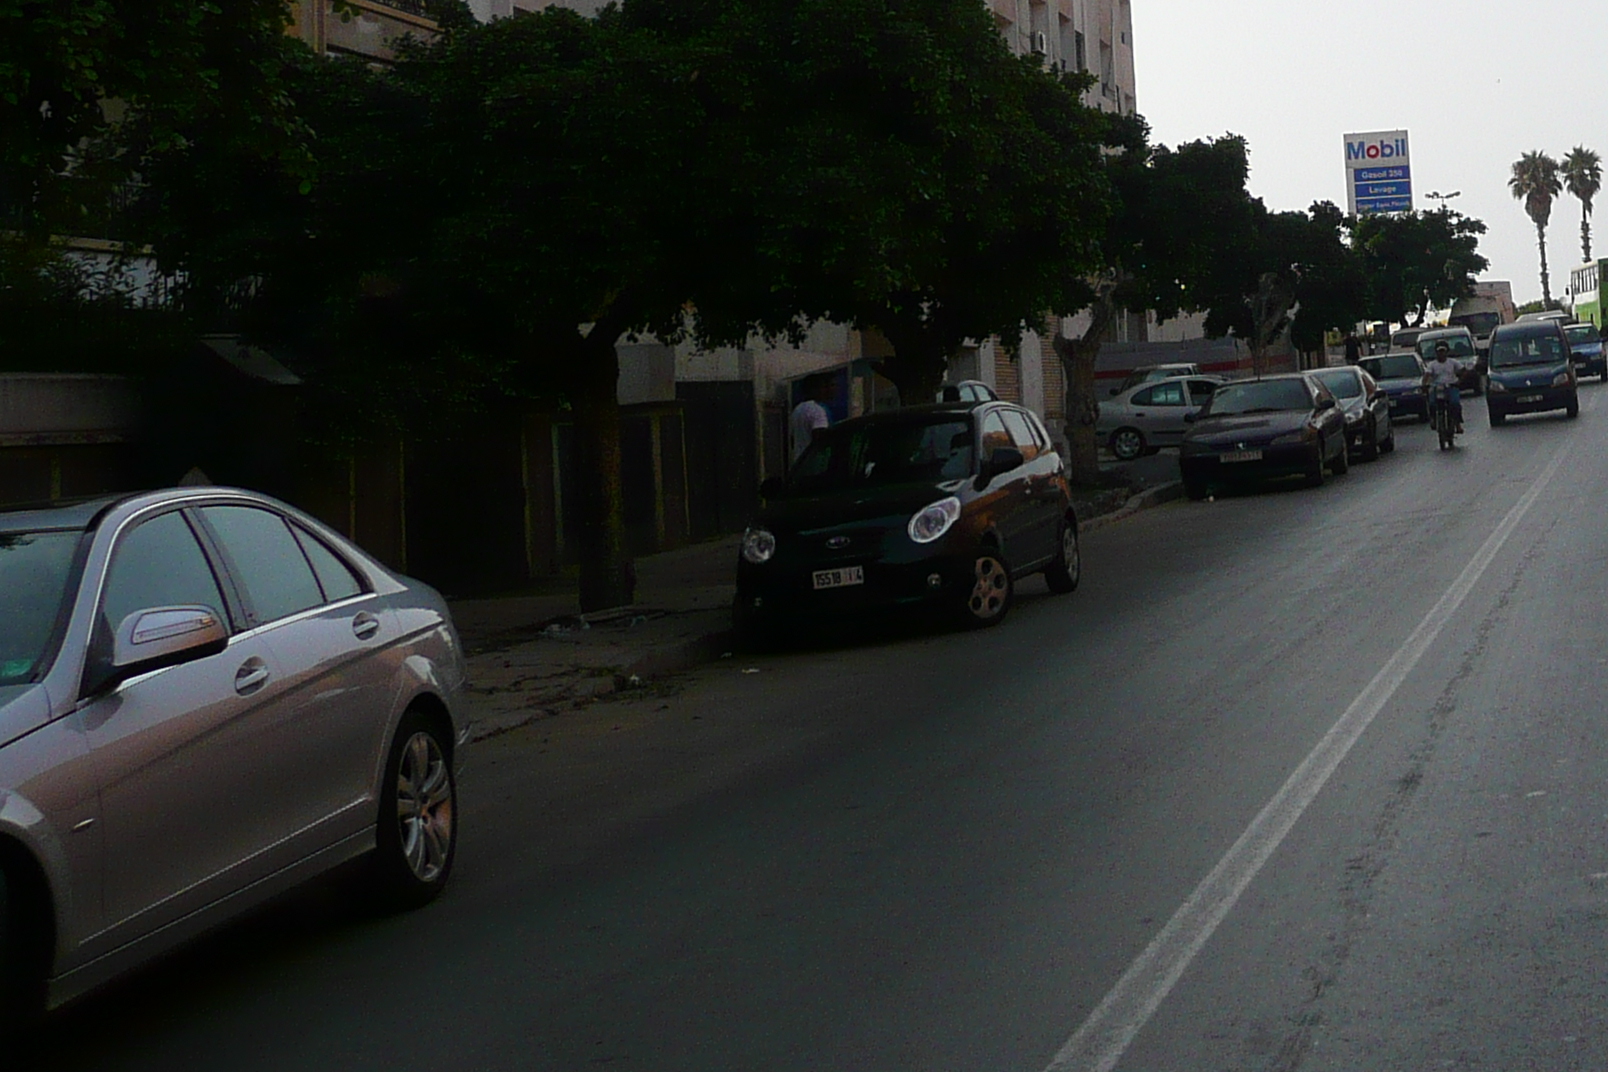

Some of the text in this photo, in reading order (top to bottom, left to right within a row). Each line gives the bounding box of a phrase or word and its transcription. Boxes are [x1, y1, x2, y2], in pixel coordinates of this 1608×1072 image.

[1346, 138, 1406, 160] Mobil
[1361, 171, 1387, 179] Gasoil
[1369, 186, 1396, 194] Lavage
